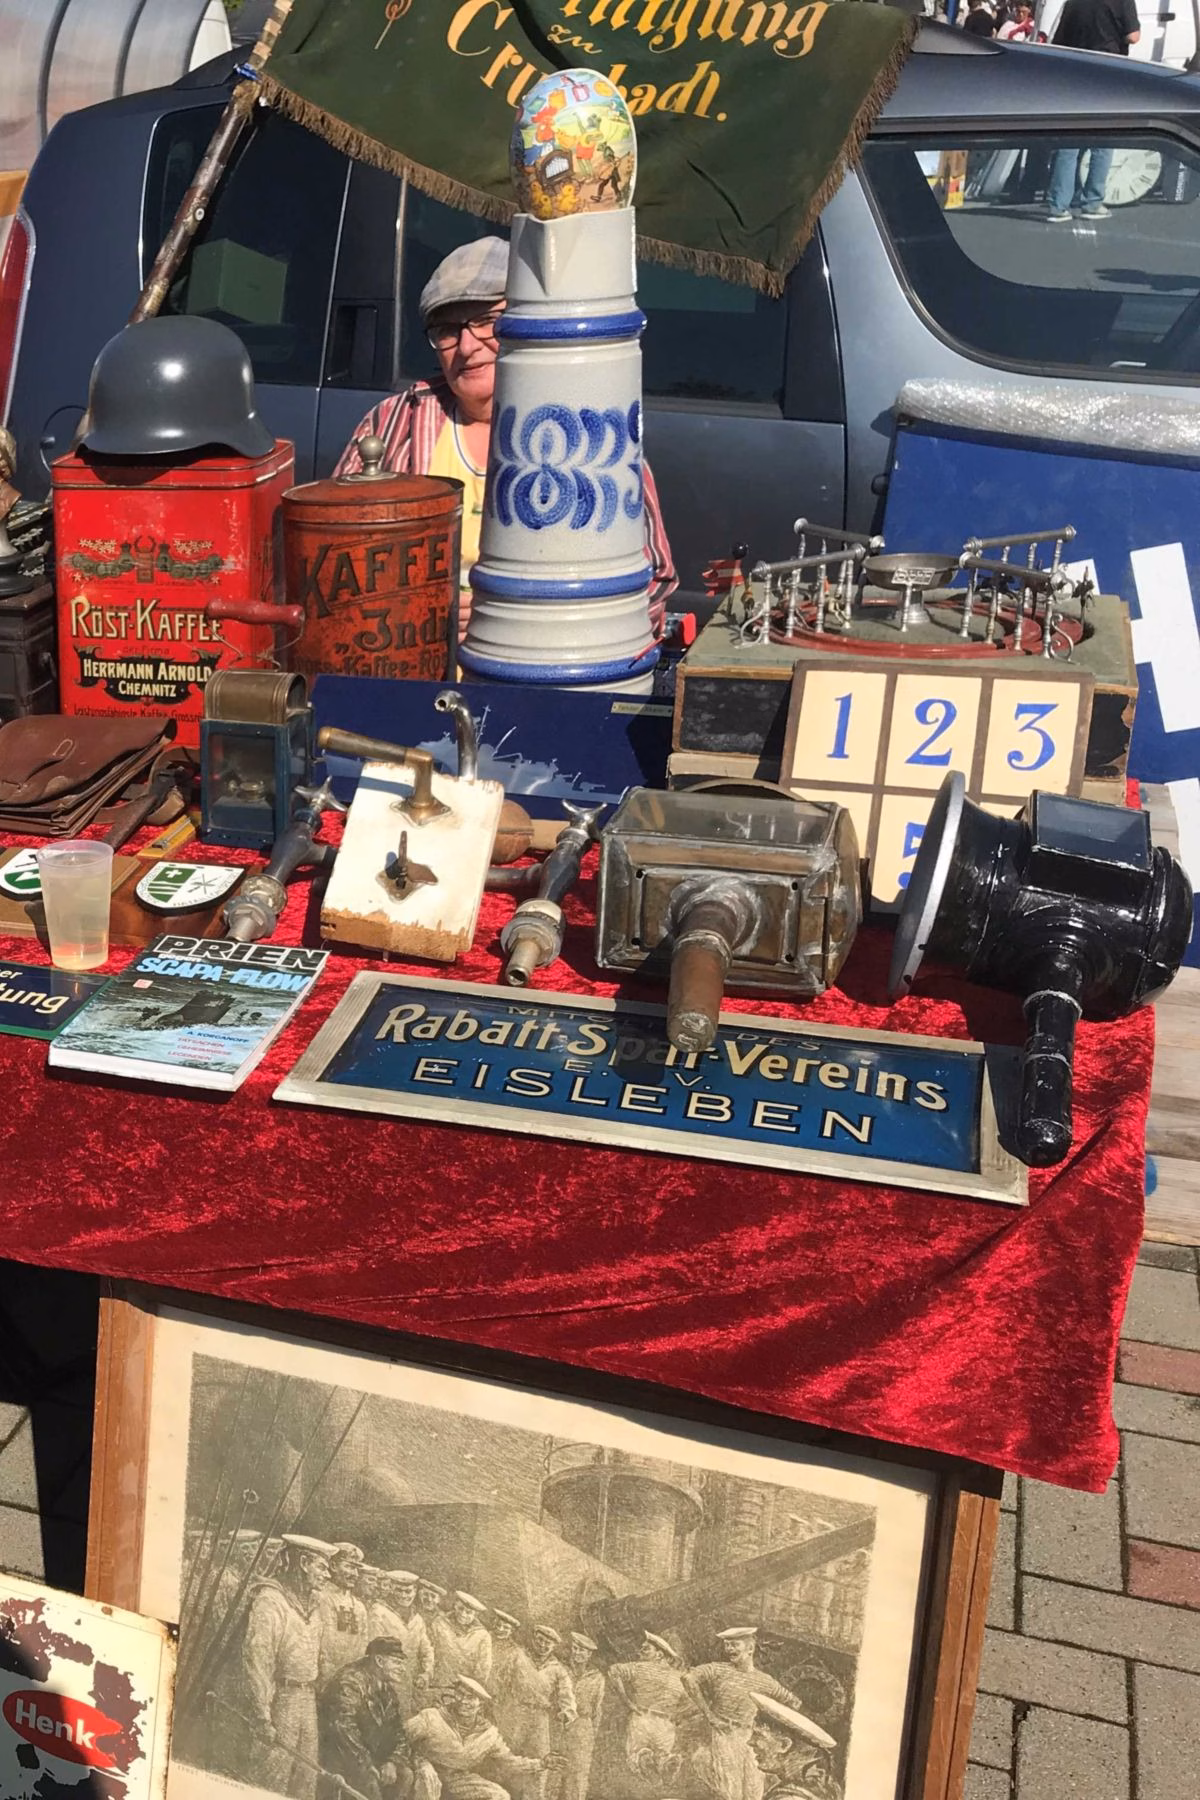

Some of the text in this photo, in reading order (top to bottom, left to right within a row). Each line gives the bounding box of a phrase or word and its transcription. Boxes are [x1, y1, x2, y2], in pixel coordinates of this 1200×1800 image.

[82, 657, 212, 683] HERRMANN ARNOLD
[117, 680, 178, 697] CHEMNITZ
[826, 692, 854, 760] 1
[904, 697, 958, 768] 2
[1006, 702, 1060, 772] 3
[152, 935, 333, 971] PRIEN
[136, 956, 313, 992] SCAPA FLOW
[737, 1031, 824, 1052] DES
[412, 1055, 873, 1144] EISLEBEN
